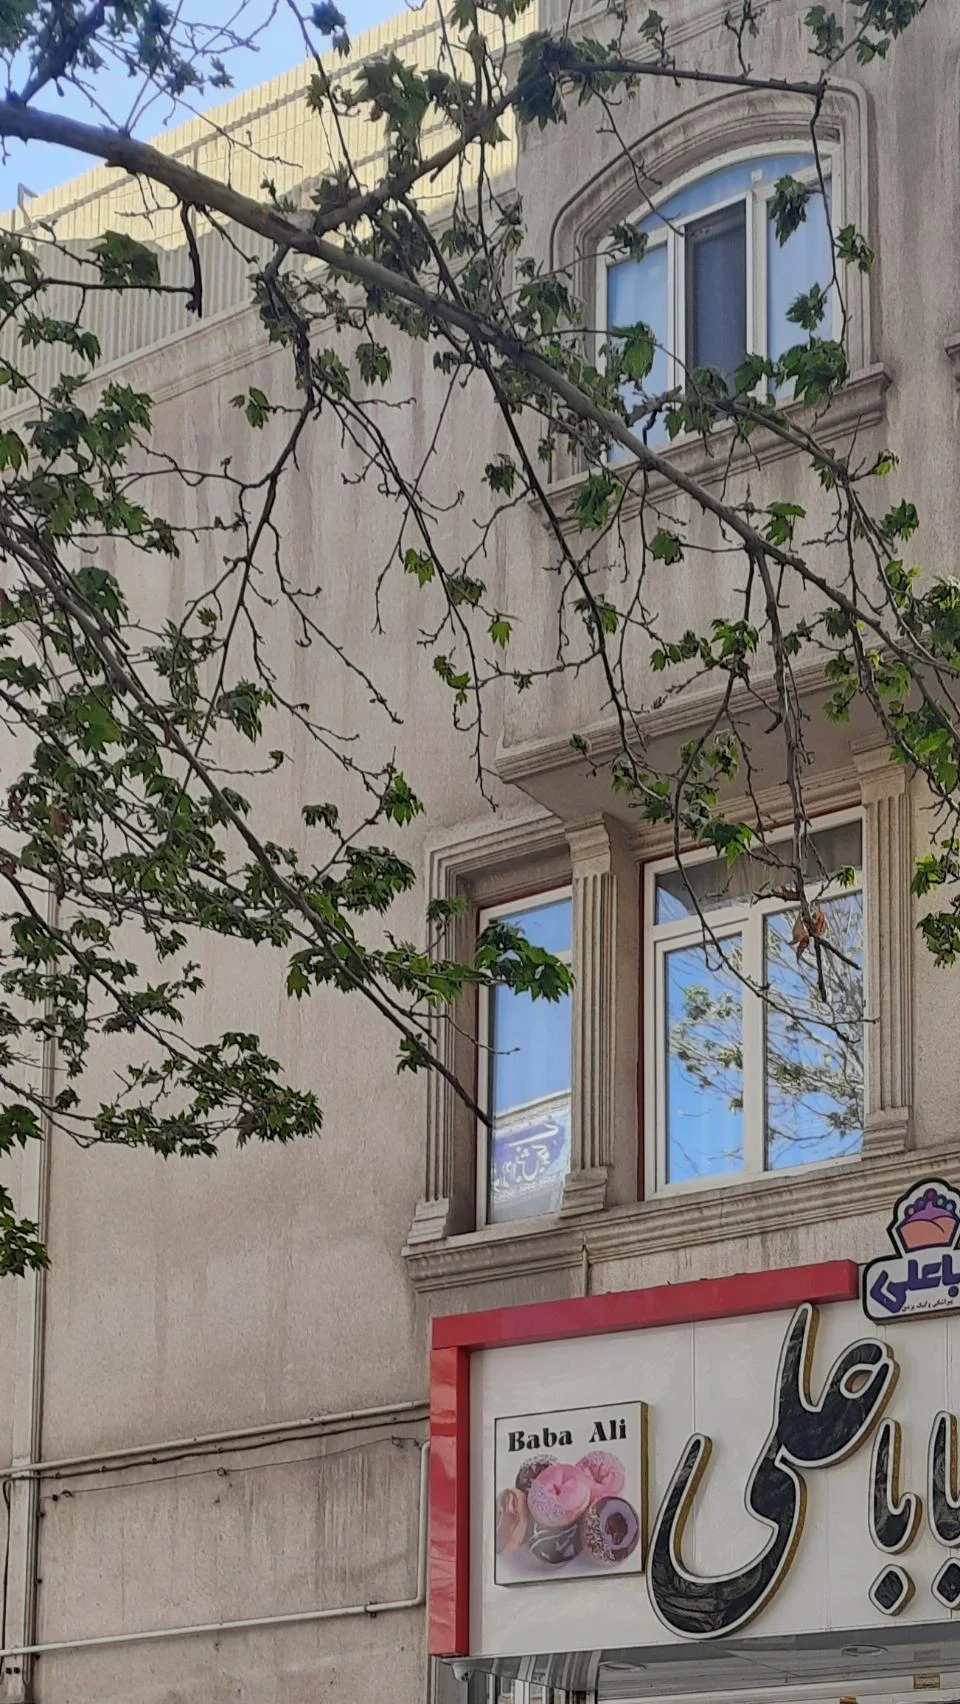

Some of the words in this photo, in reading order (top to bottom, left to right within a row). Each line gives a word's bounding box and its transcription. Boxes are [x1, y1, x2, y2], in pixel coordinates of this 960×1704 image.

[508, 1427, 573, 1452] Baba
[588, 1416, 627, 1443] Ali
[646, 1302, 901, 1640] علی
